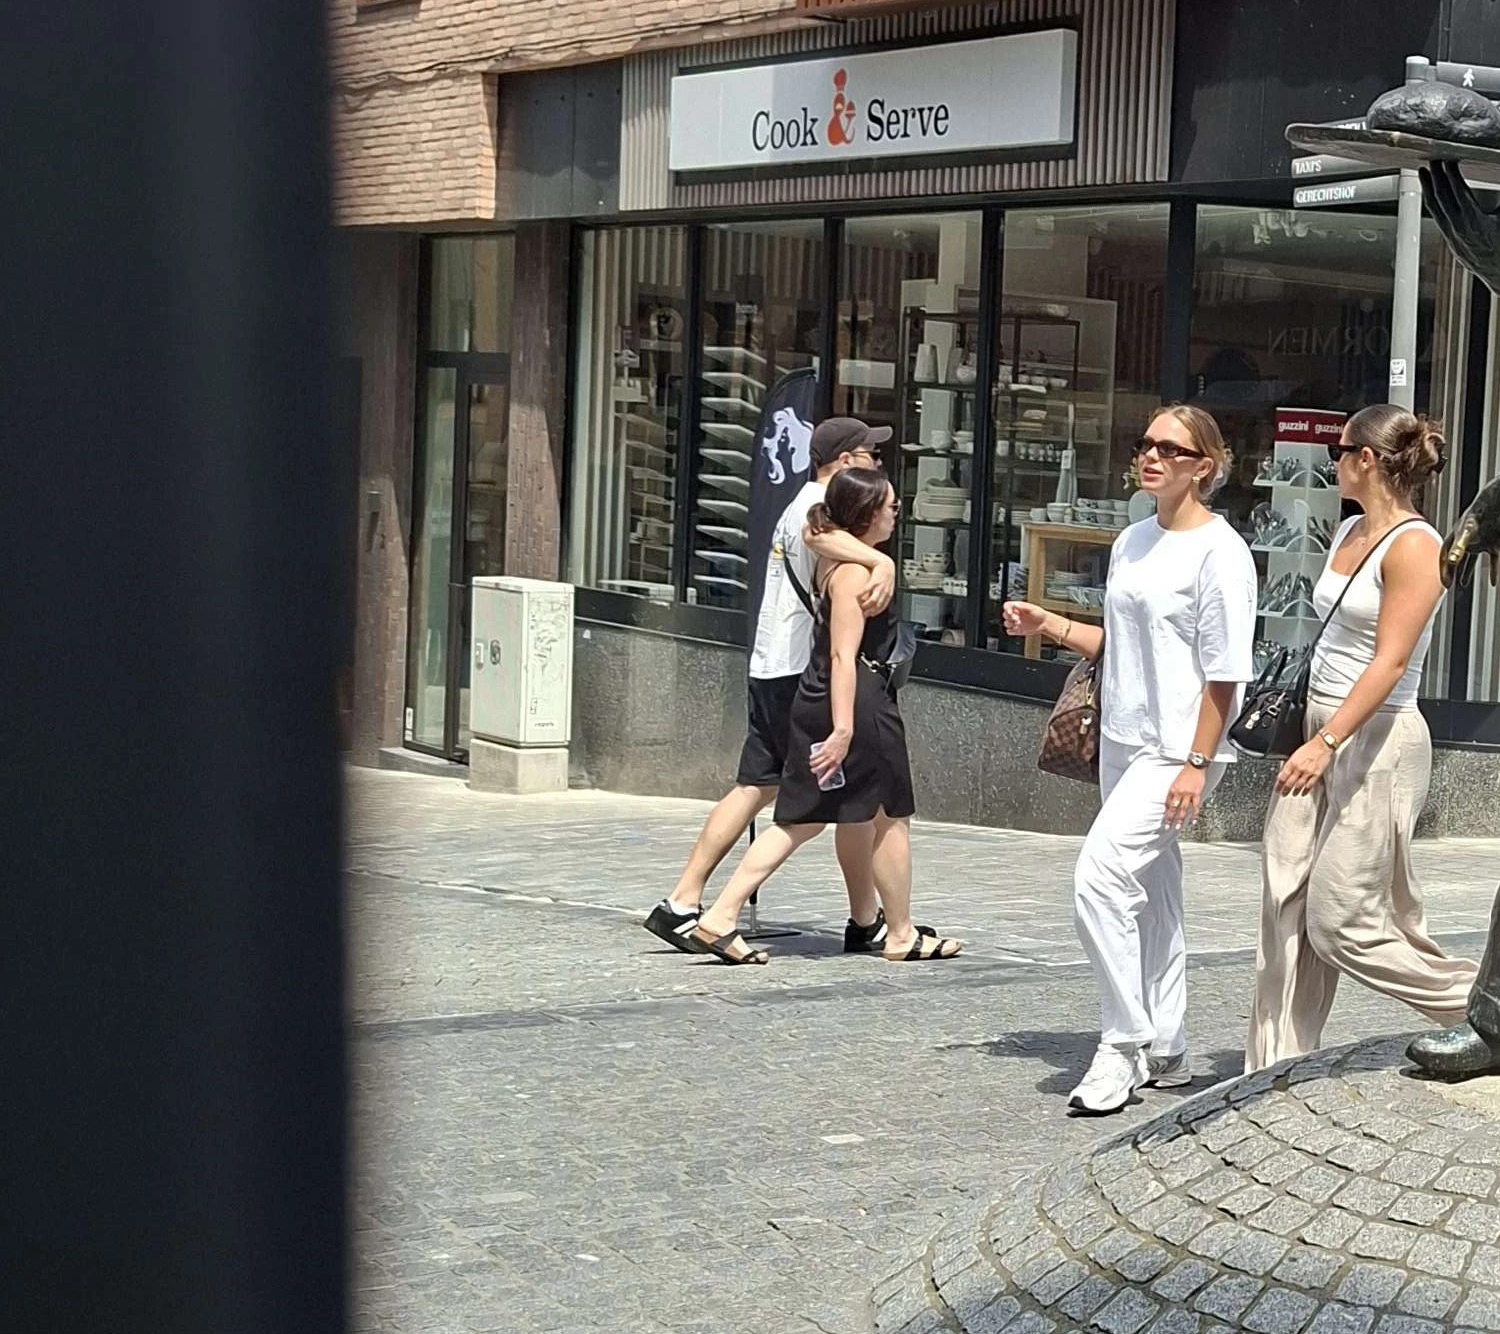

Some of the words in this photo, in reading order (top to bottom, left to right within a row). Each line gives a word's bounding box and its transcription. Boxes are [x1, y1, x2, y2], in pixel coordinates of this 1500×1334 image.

[752, 106, 819, 151] Cook
[866, 98, 950, 142] Serve
[1296, 186, 1357, 203] GERECHTSHOF
[1278, 420, 1309, 432] guzzini
